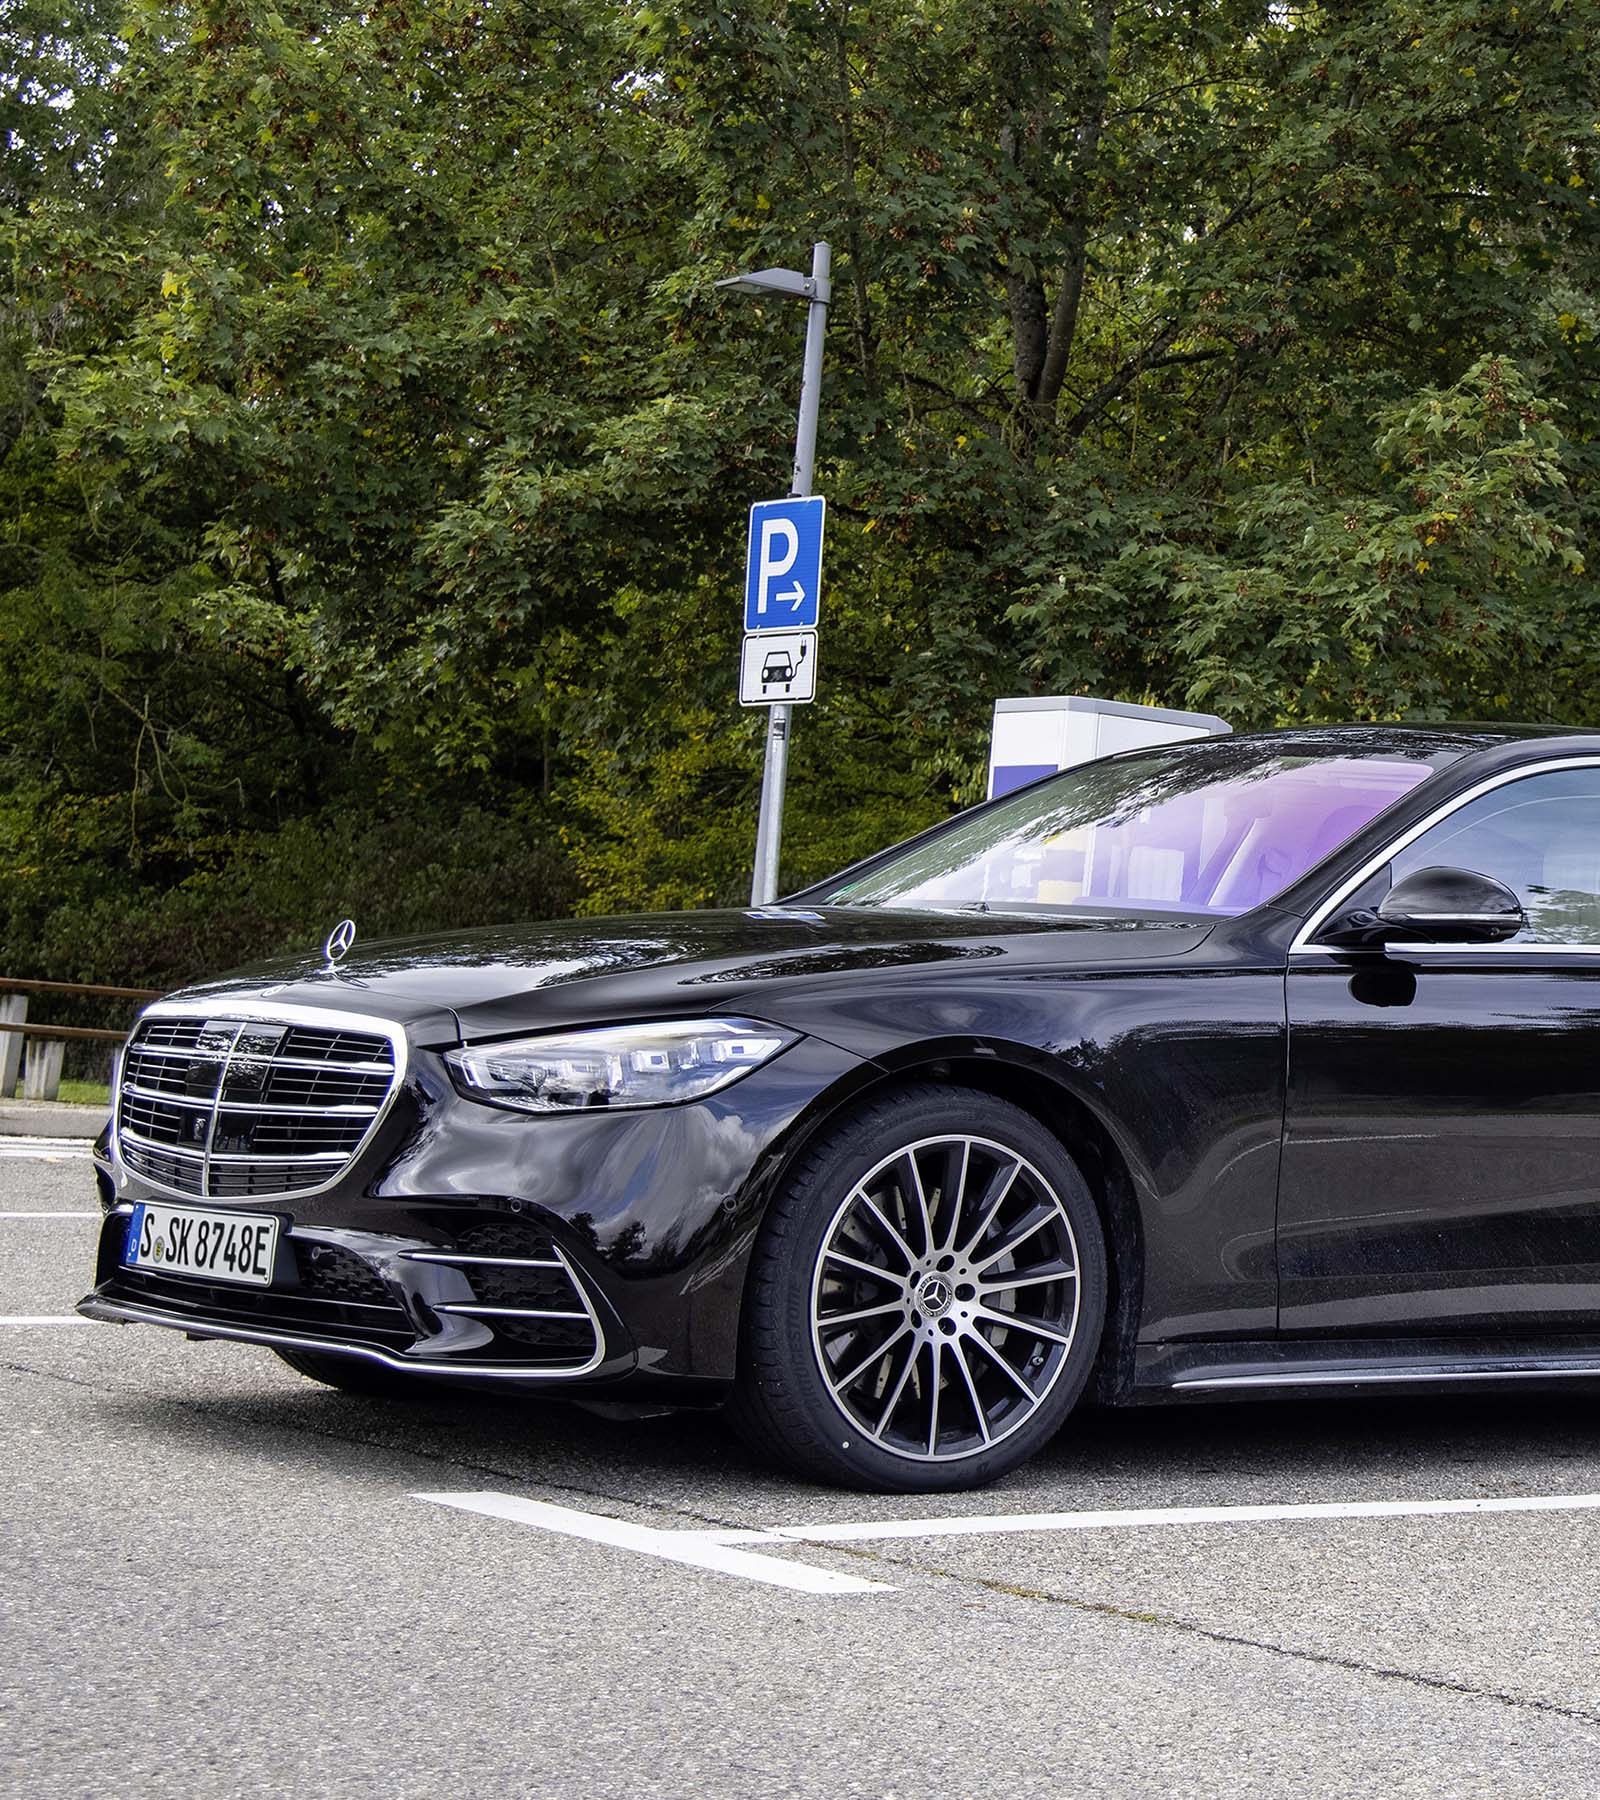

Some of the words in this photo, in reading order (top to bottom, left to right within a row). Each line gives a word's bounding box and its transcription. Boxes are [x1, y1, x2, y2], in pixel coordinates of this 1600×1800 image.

[757, 518, 799, 614] P
[140, 1213, 155, 1257] S
[165, 1217, 194, 1266] SK
[194, 1220, 270, 1275] 8748E
